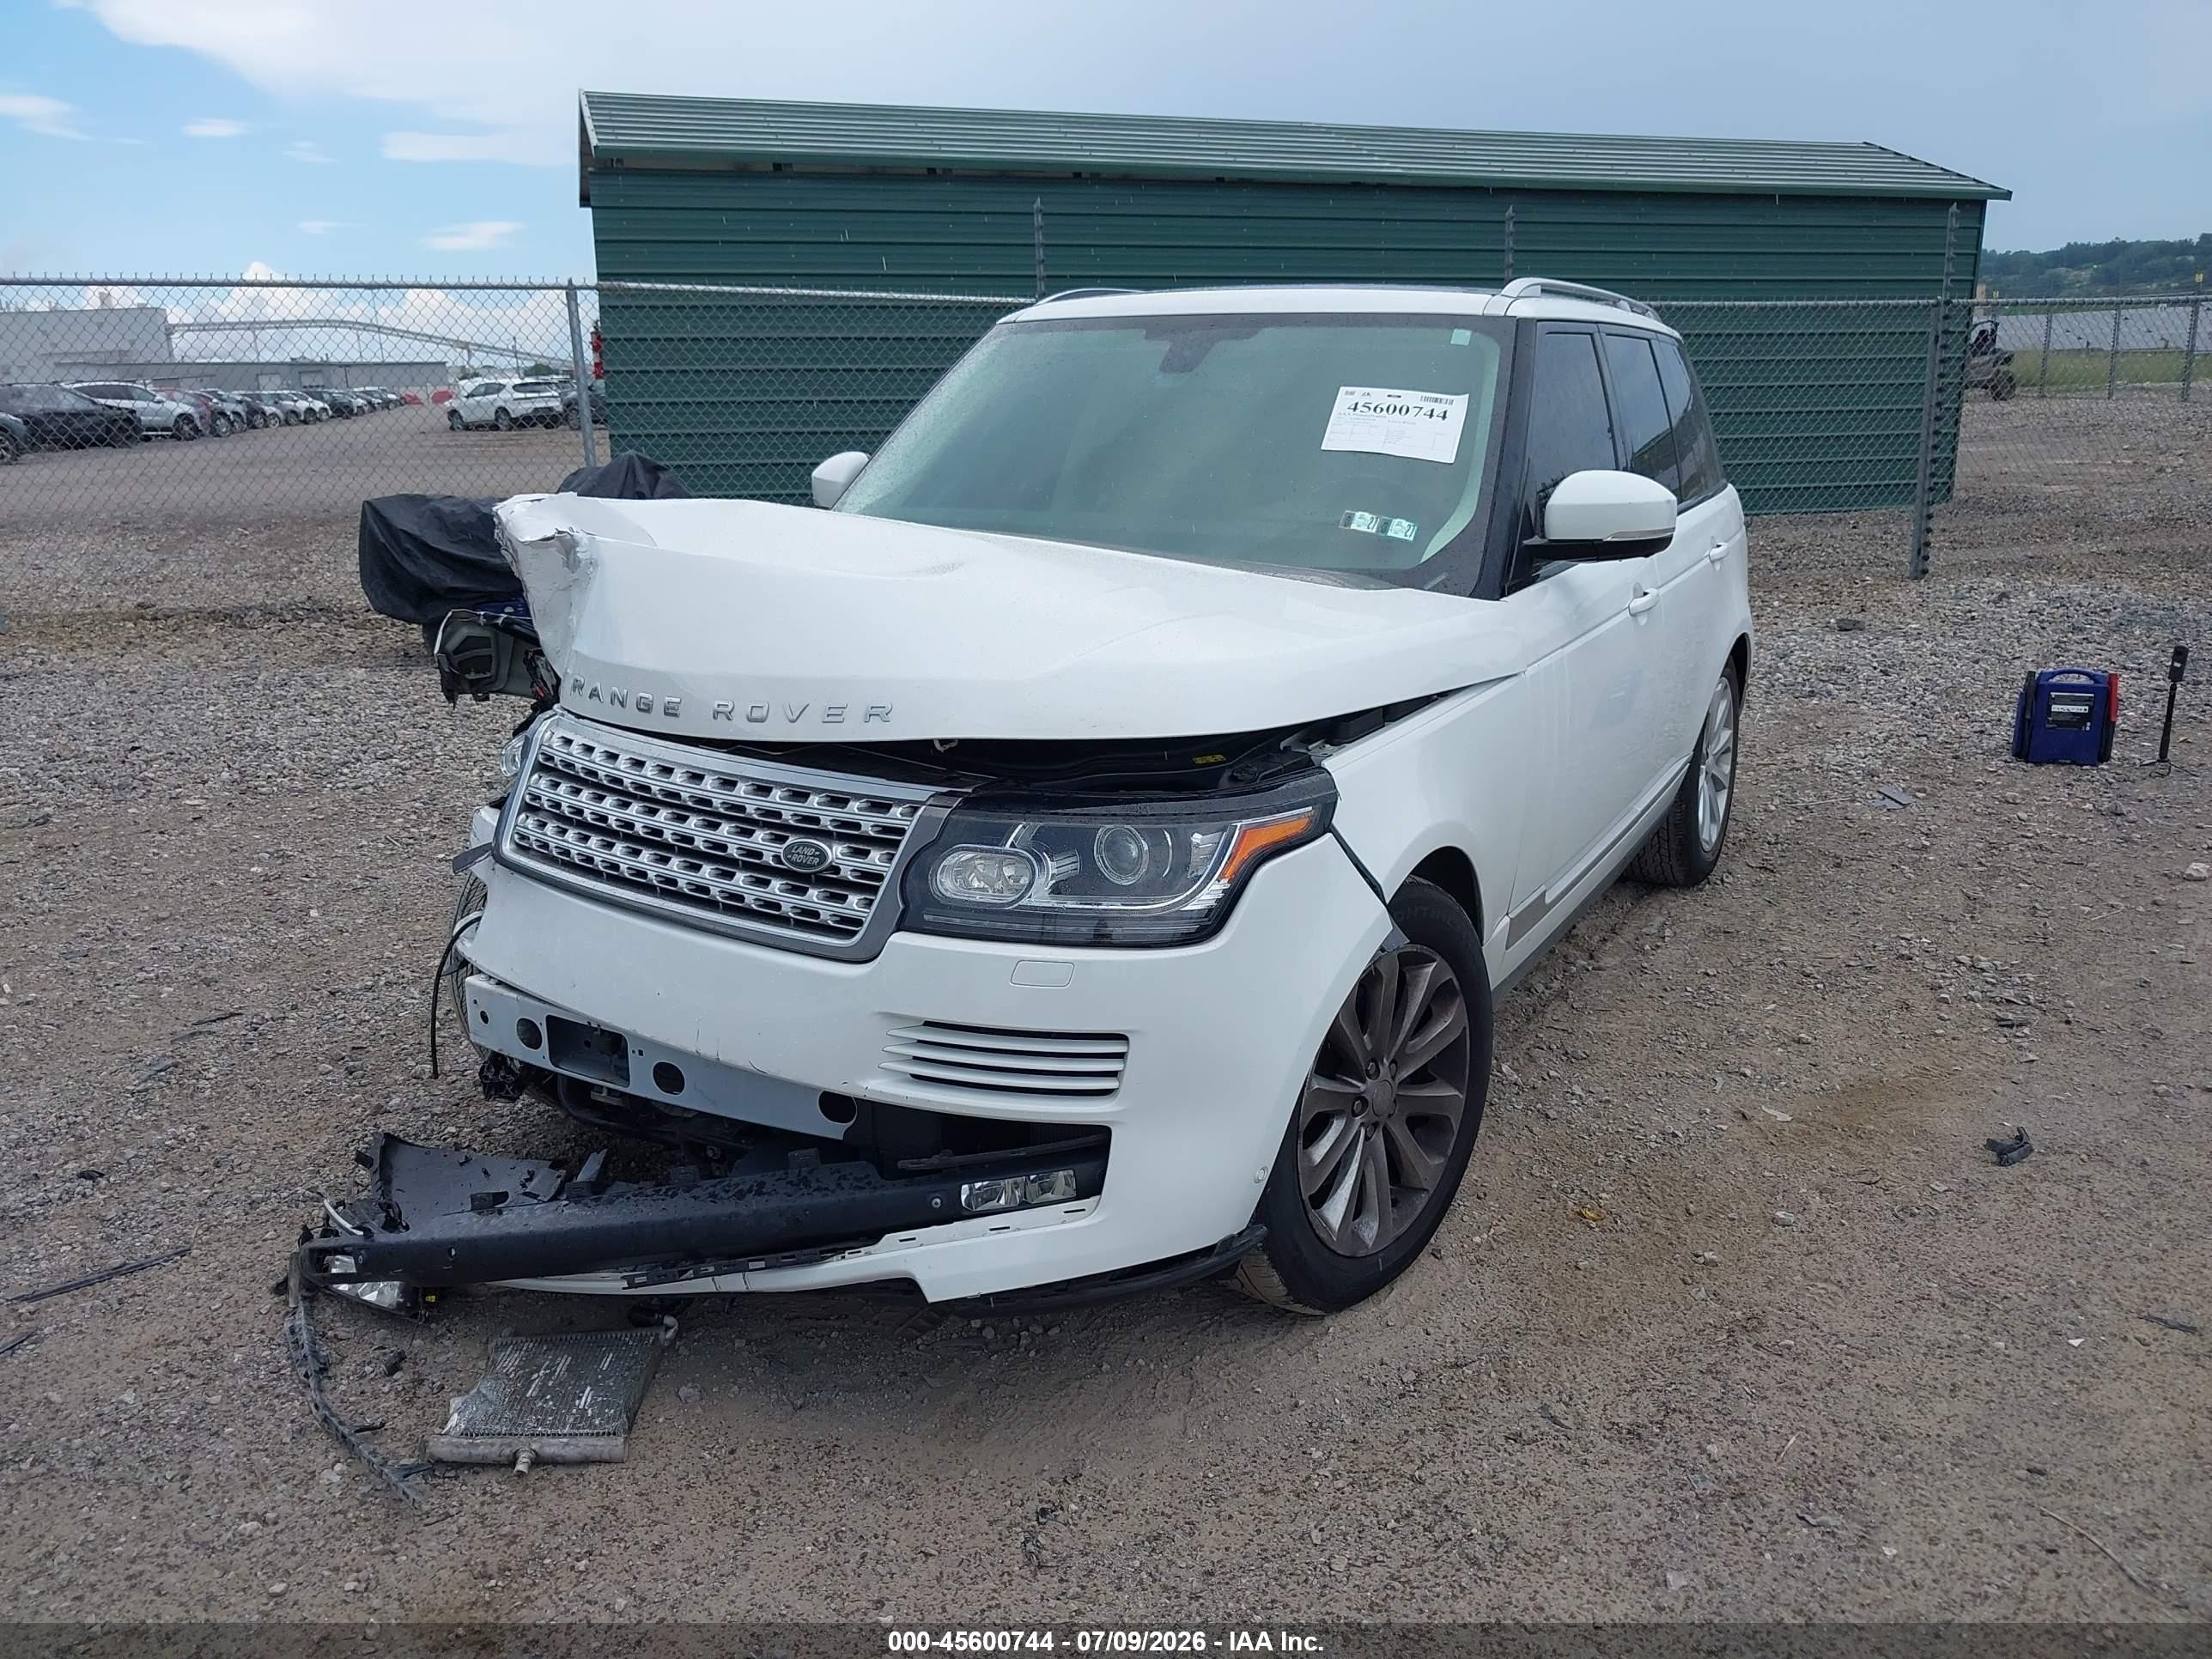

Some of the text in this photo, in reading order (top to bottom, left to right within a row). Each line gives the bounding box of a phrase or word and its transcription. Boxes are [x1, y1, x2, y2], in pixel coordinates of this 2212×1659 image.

[1347, 401, 1449, 421] 45600744
[570, 674, 894, 723] RANGE ROVER
[792, 846, 815, 855] LAND
[791, 854, 819, 866] ROVER
